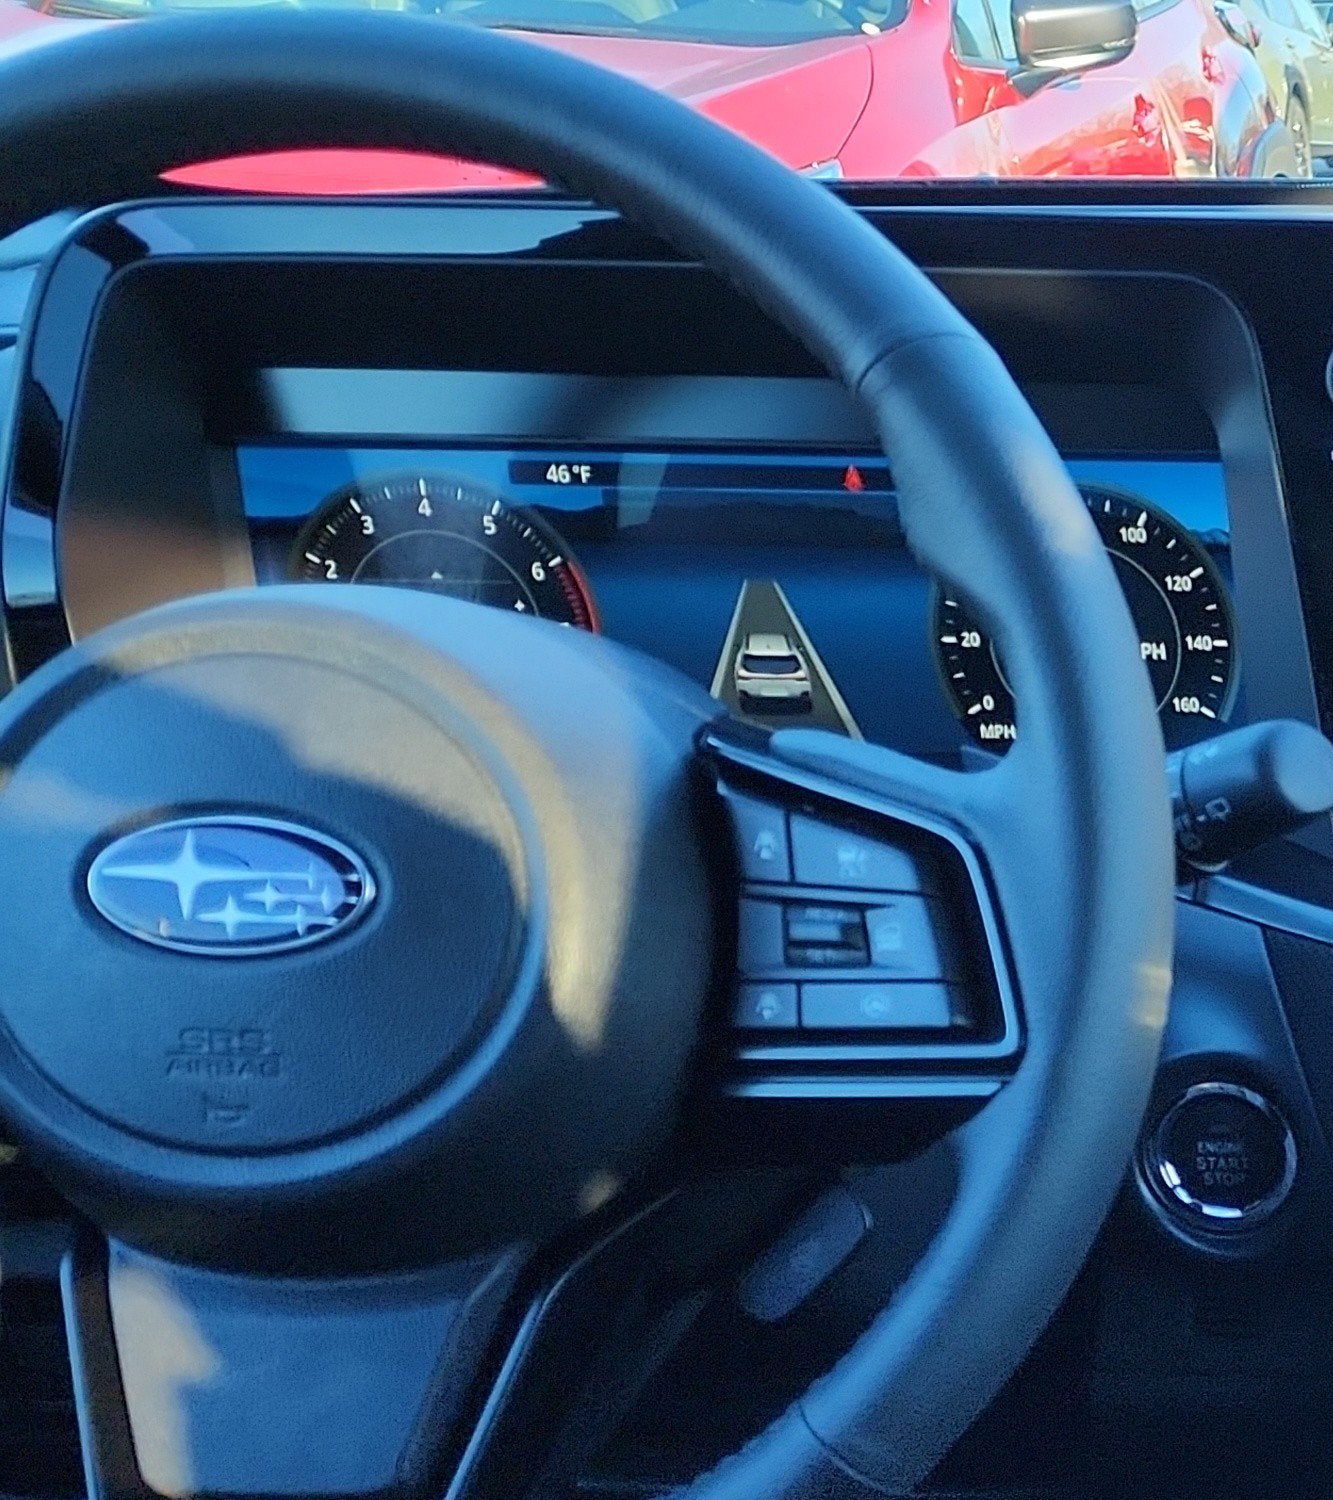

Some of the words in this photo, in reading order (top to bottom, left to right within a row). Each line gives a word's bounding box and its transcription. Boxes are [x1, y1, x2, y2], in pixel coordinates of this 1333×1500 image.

[546, 464, 591, 484] 46°F
[418, 498, 432, 517] 4
[361, 515, 374, 535] 3
[483, 515, 497, 536] 5
[1119, 527, 1147, 544] 100
[324, 559, 338, 579] 2
[531, 561, 546, 581] 6
[1165, 575, 1193, 592] 120
[960, 631, 981, 648] 20
[1185, 635, 1213, 652] 140
[1140, 642, 1167, 661] PH
[983, 695, 994, 711] 0
[1172, 697, 1200, 714] 160
[979, 724, 1016, 740] MPH
